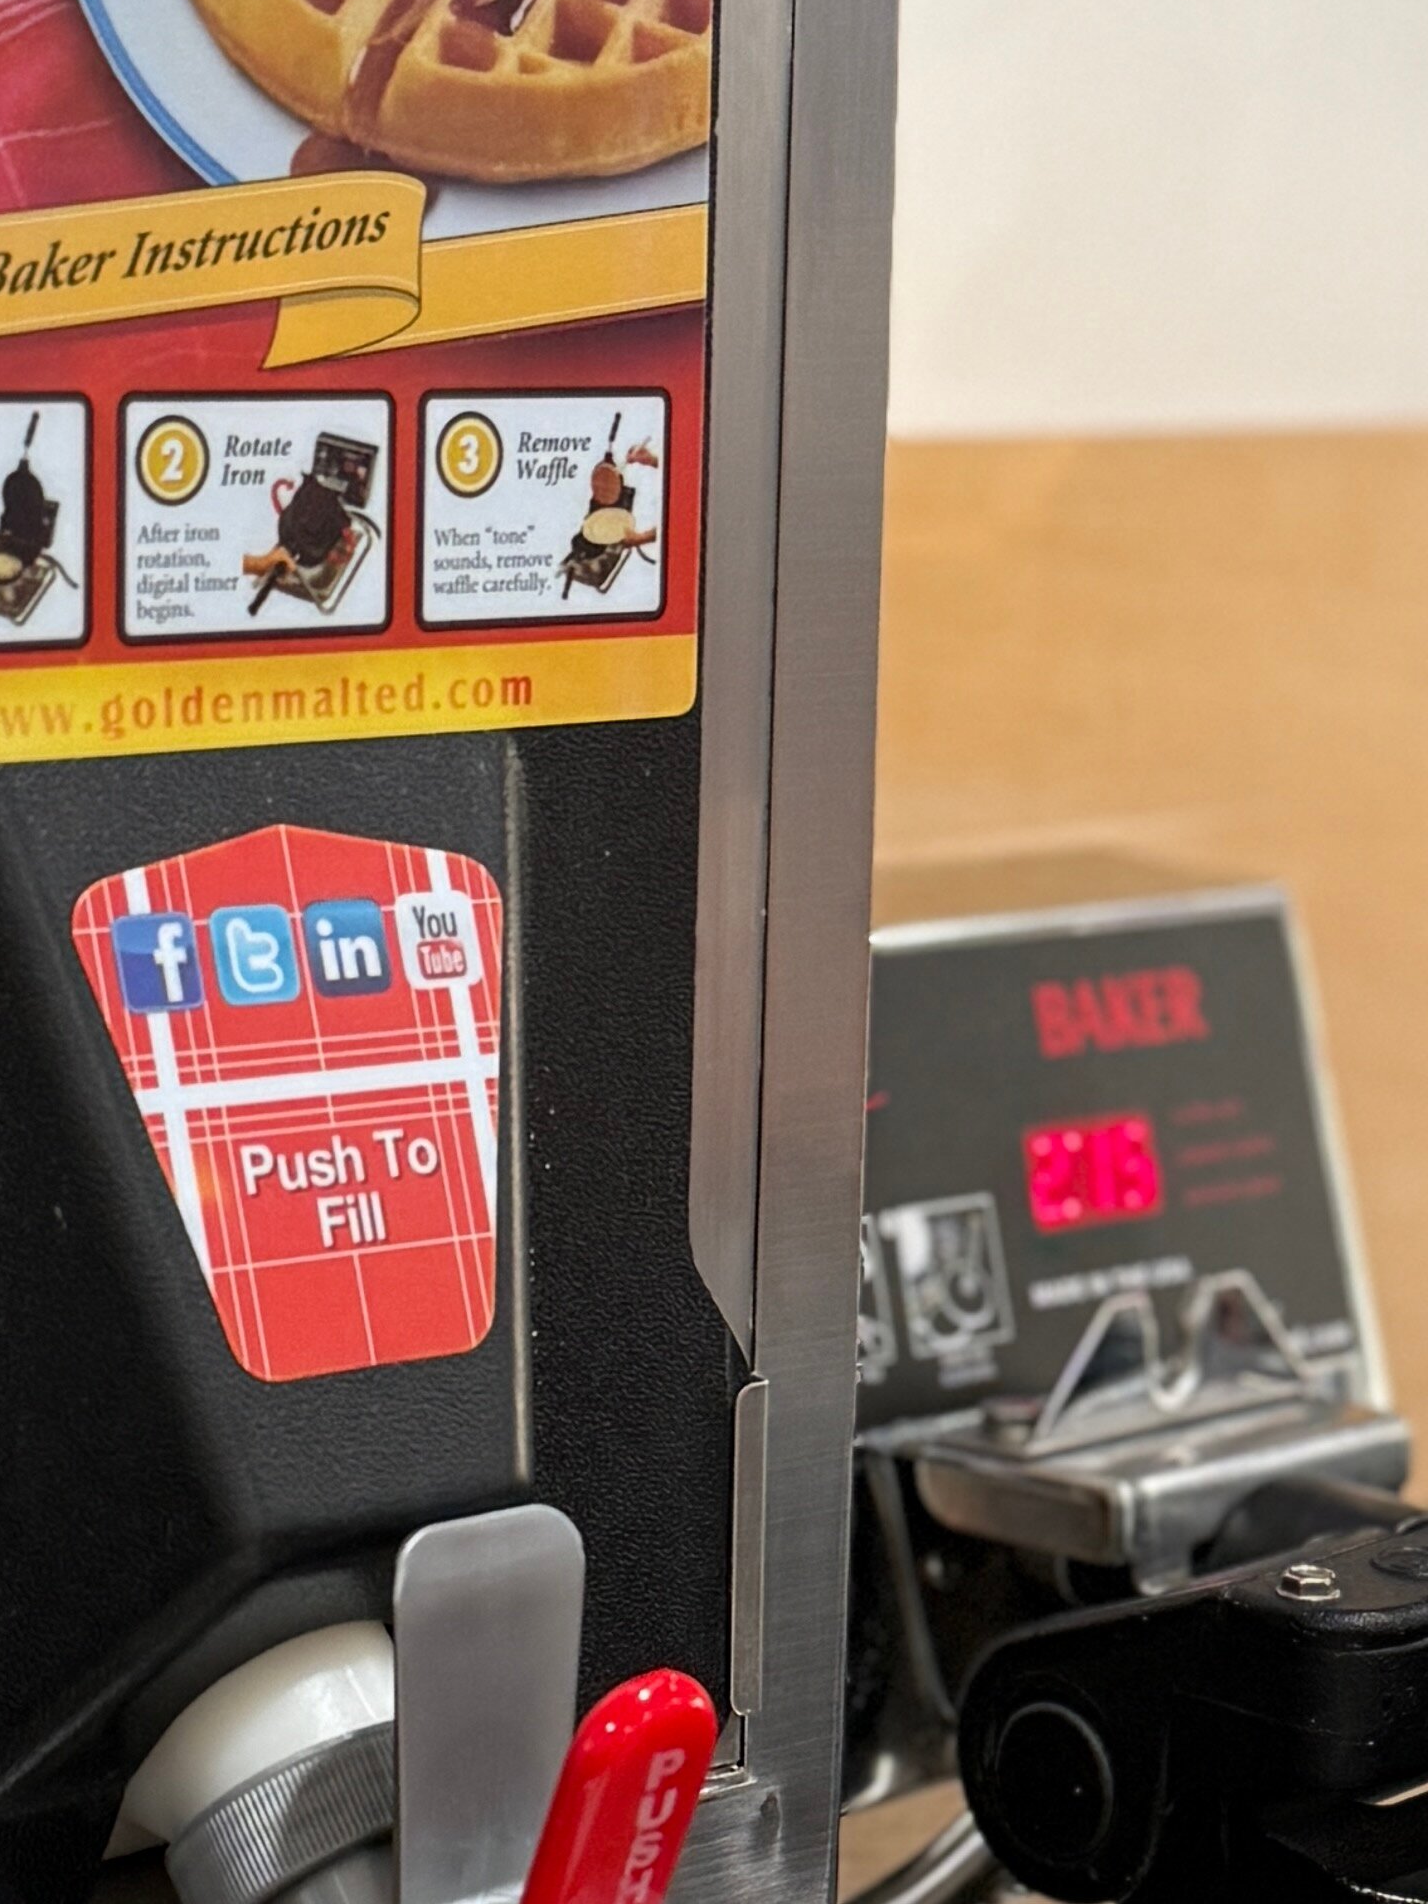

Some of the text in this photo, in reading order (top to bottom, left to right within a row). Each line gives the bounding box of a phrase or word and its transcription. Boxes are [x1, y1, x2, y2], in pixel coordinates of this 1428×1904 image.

[122, 205, 391, 280] Instructions
[223, 434, 293, 459] Rotate
[457, 433, 480, 476] 3
[516, 431, 593, 454] Remove
[159, 438, 185, 483] 2
[517, 456, 579, 486] Waffle
[220, 463, 267, 487] Iron
[137, 523, 220, 545] After iron
[434, 527, 481, 548] When
[137, 550, 211, 571] rotation,
[433, 552, 554, 573] sounds, remove
[136, 574, 240, 598] digital timer
[433, 572, 553, 597] waffle carefully.
[136, 600, 195, 625] begins.
[412, 904, 459, 939] You
[315, 917, 383, 982] in
[418, 945, 467, 976] Tube
[1031, 965, 1210, 1059] BAKER
[239, 1129, 440, 1197] Push To
[316, 1192, 389, 1249] Fill
